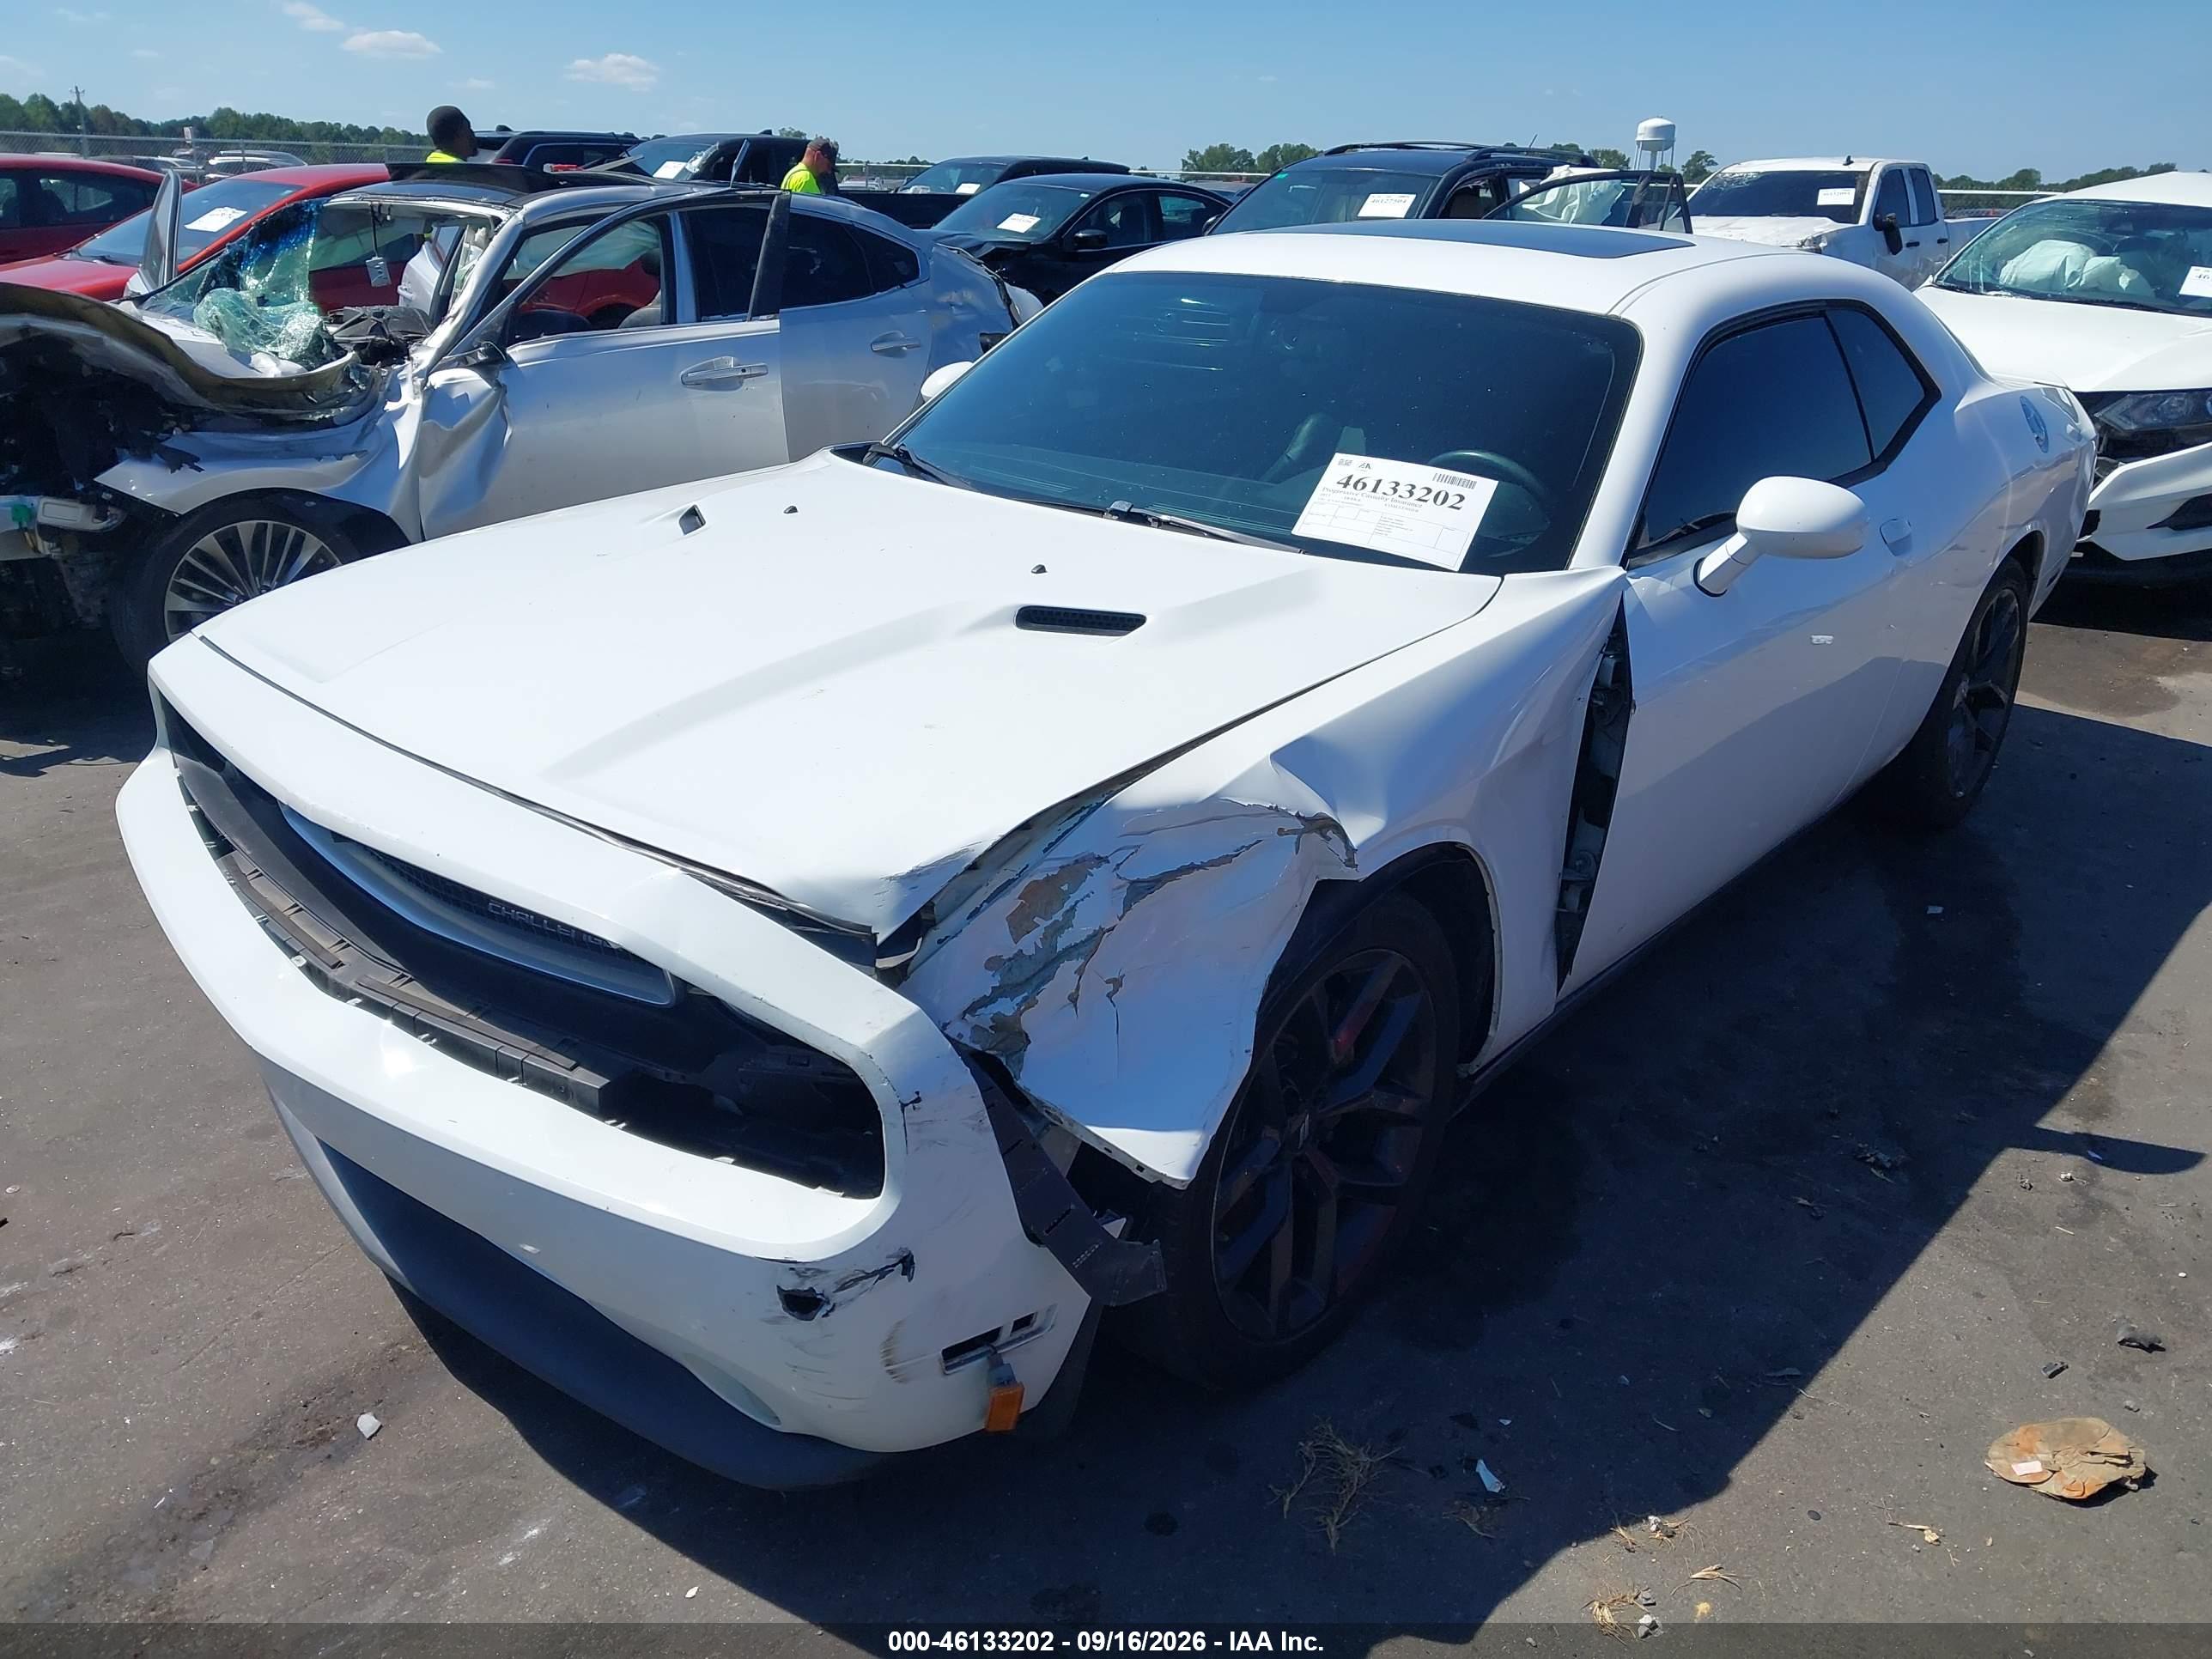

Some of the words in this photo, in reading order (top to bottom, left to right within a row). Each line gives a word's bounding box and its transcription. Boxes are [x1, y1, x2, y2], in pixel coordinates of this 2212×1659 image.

[1336, 474, 1466, 510] 46133202
[1391, 497, 1423, 507] Insurance
[488, 902, 612, 948] CHALLENG
